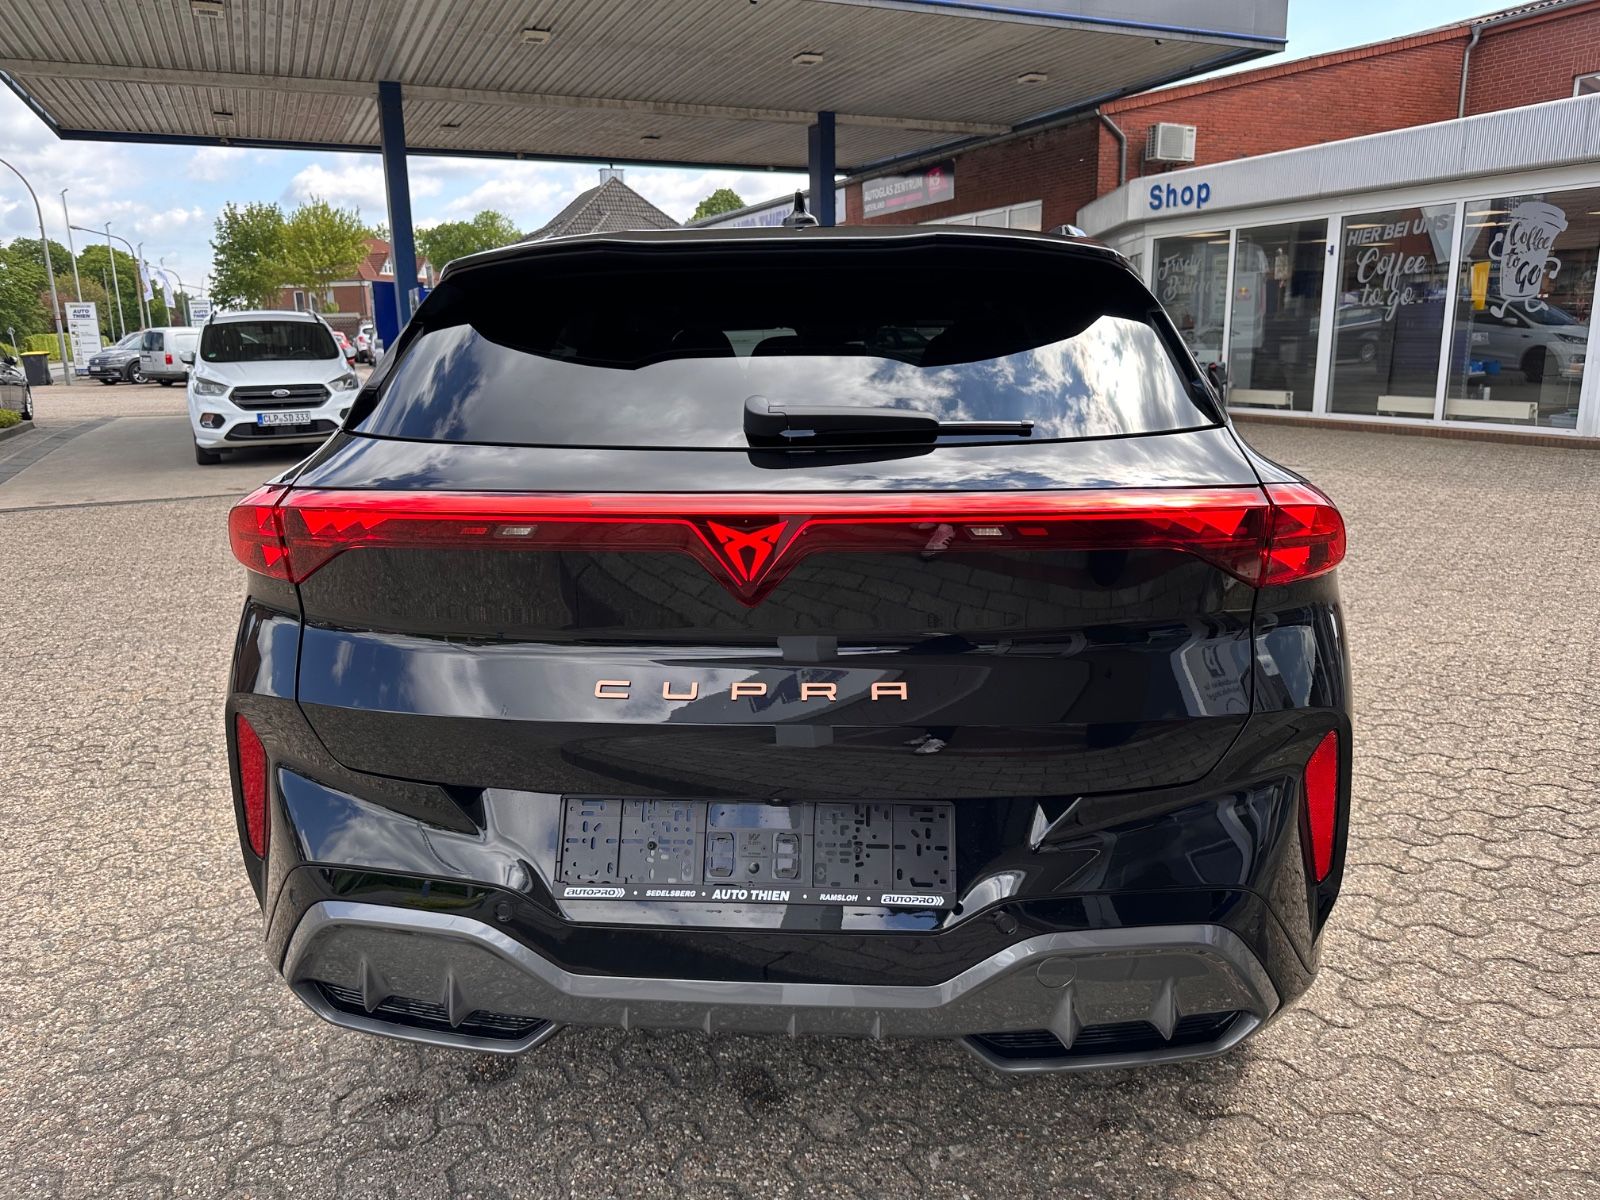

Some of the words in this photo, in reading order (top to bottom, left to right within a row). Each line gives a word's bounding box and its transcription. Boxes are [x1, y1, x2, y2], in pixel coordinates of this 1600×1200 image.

[1149, 182, 1210, 210] Shop
[1347, 228, 1381, 247] HIER
[1383, 221, 1410, 240] BEI
[1412, 214, 1450, 235] UNS
[1509, 221, 1551, 252] Coffee
[1356, 247, 1426, 291] Coffee
[1504, 247, 1521, 269] to
[1360, 283, 1384, 306] to
[1385, 287, 1414, 322] go
[295, 413, 310, 422] 333
[593, 679, 908, 702] CUPRA
[645, 889, 696, 898] SEDELSBERG
[712, 889, 748, 900] AUTO
[750, 889, 791, 901] THIEN
[819, 893, 859, 902] RAMSLOH
